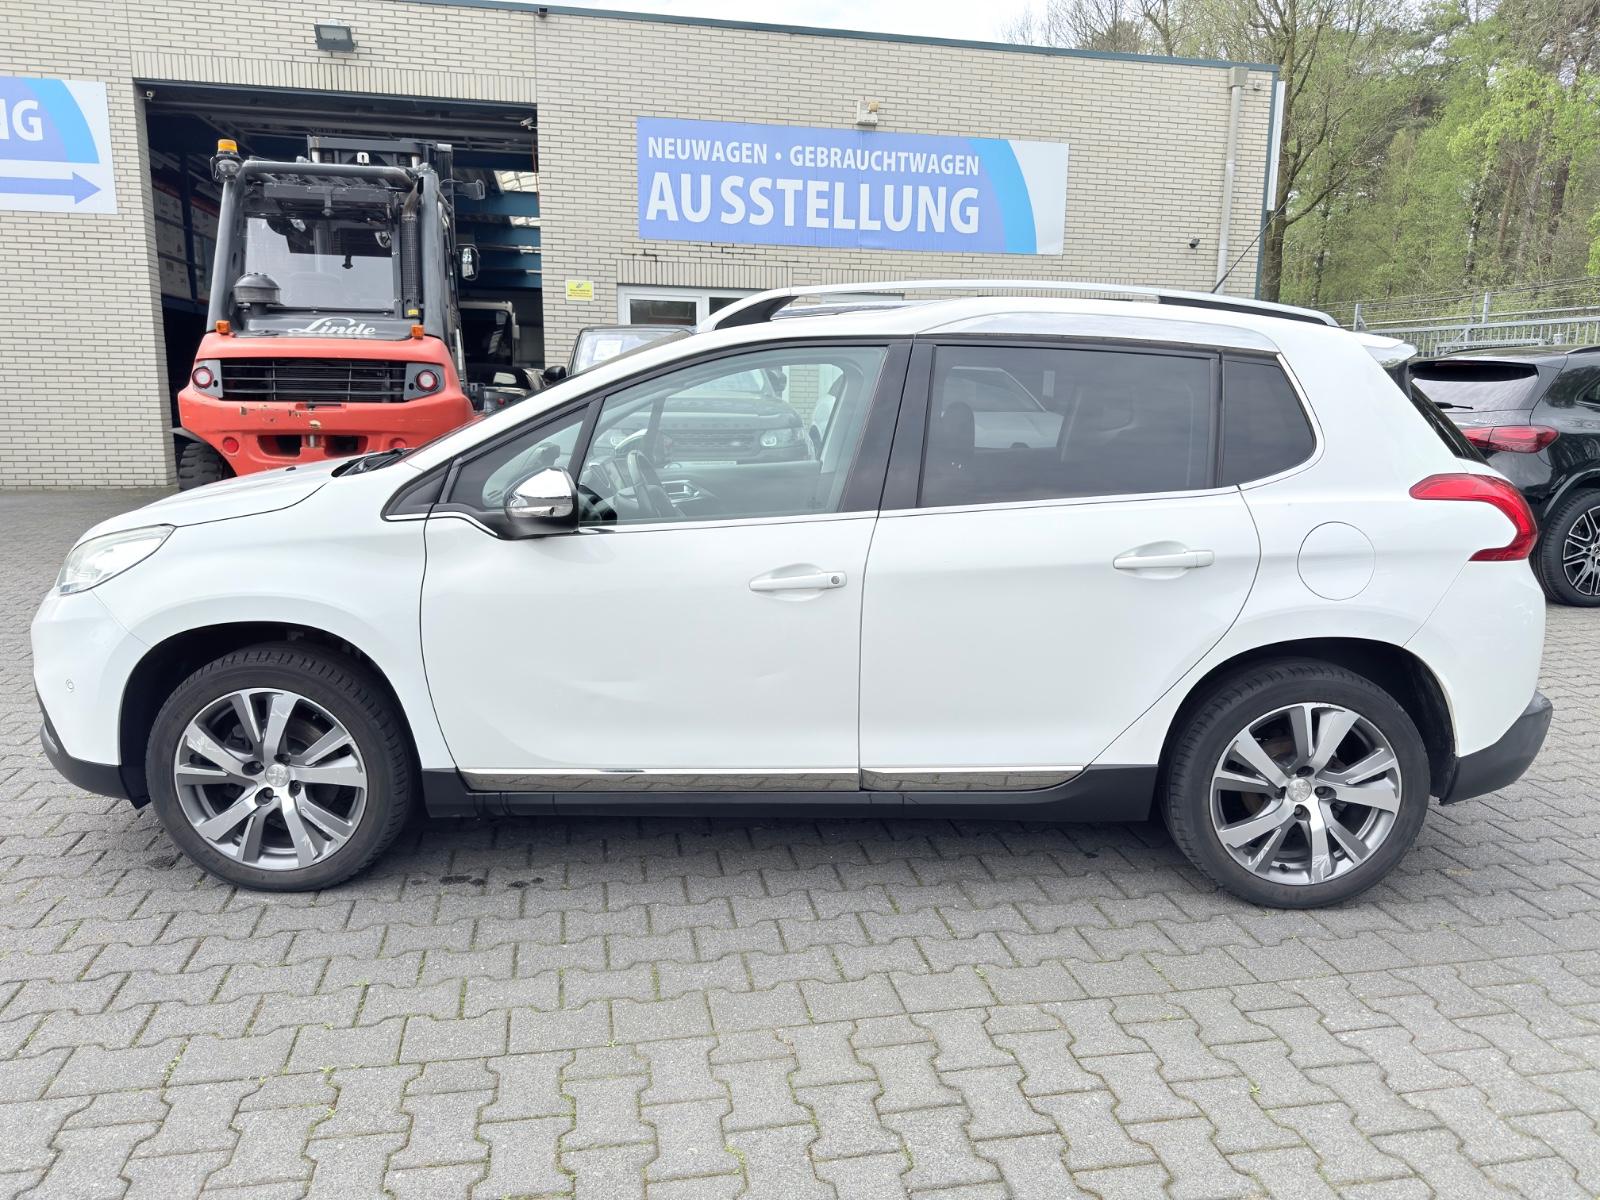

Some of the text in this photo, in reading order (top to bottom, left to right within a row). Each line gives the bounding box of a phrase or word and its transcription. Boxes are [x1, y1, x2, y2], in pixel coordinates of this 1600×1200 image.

[648, 137, 979, 176] NEUWAGEN GEBRAUCHTWAGEN
[646, 172, 979, 234] AUSSTELLUNG
[287, 316, 376, 335] Linde
